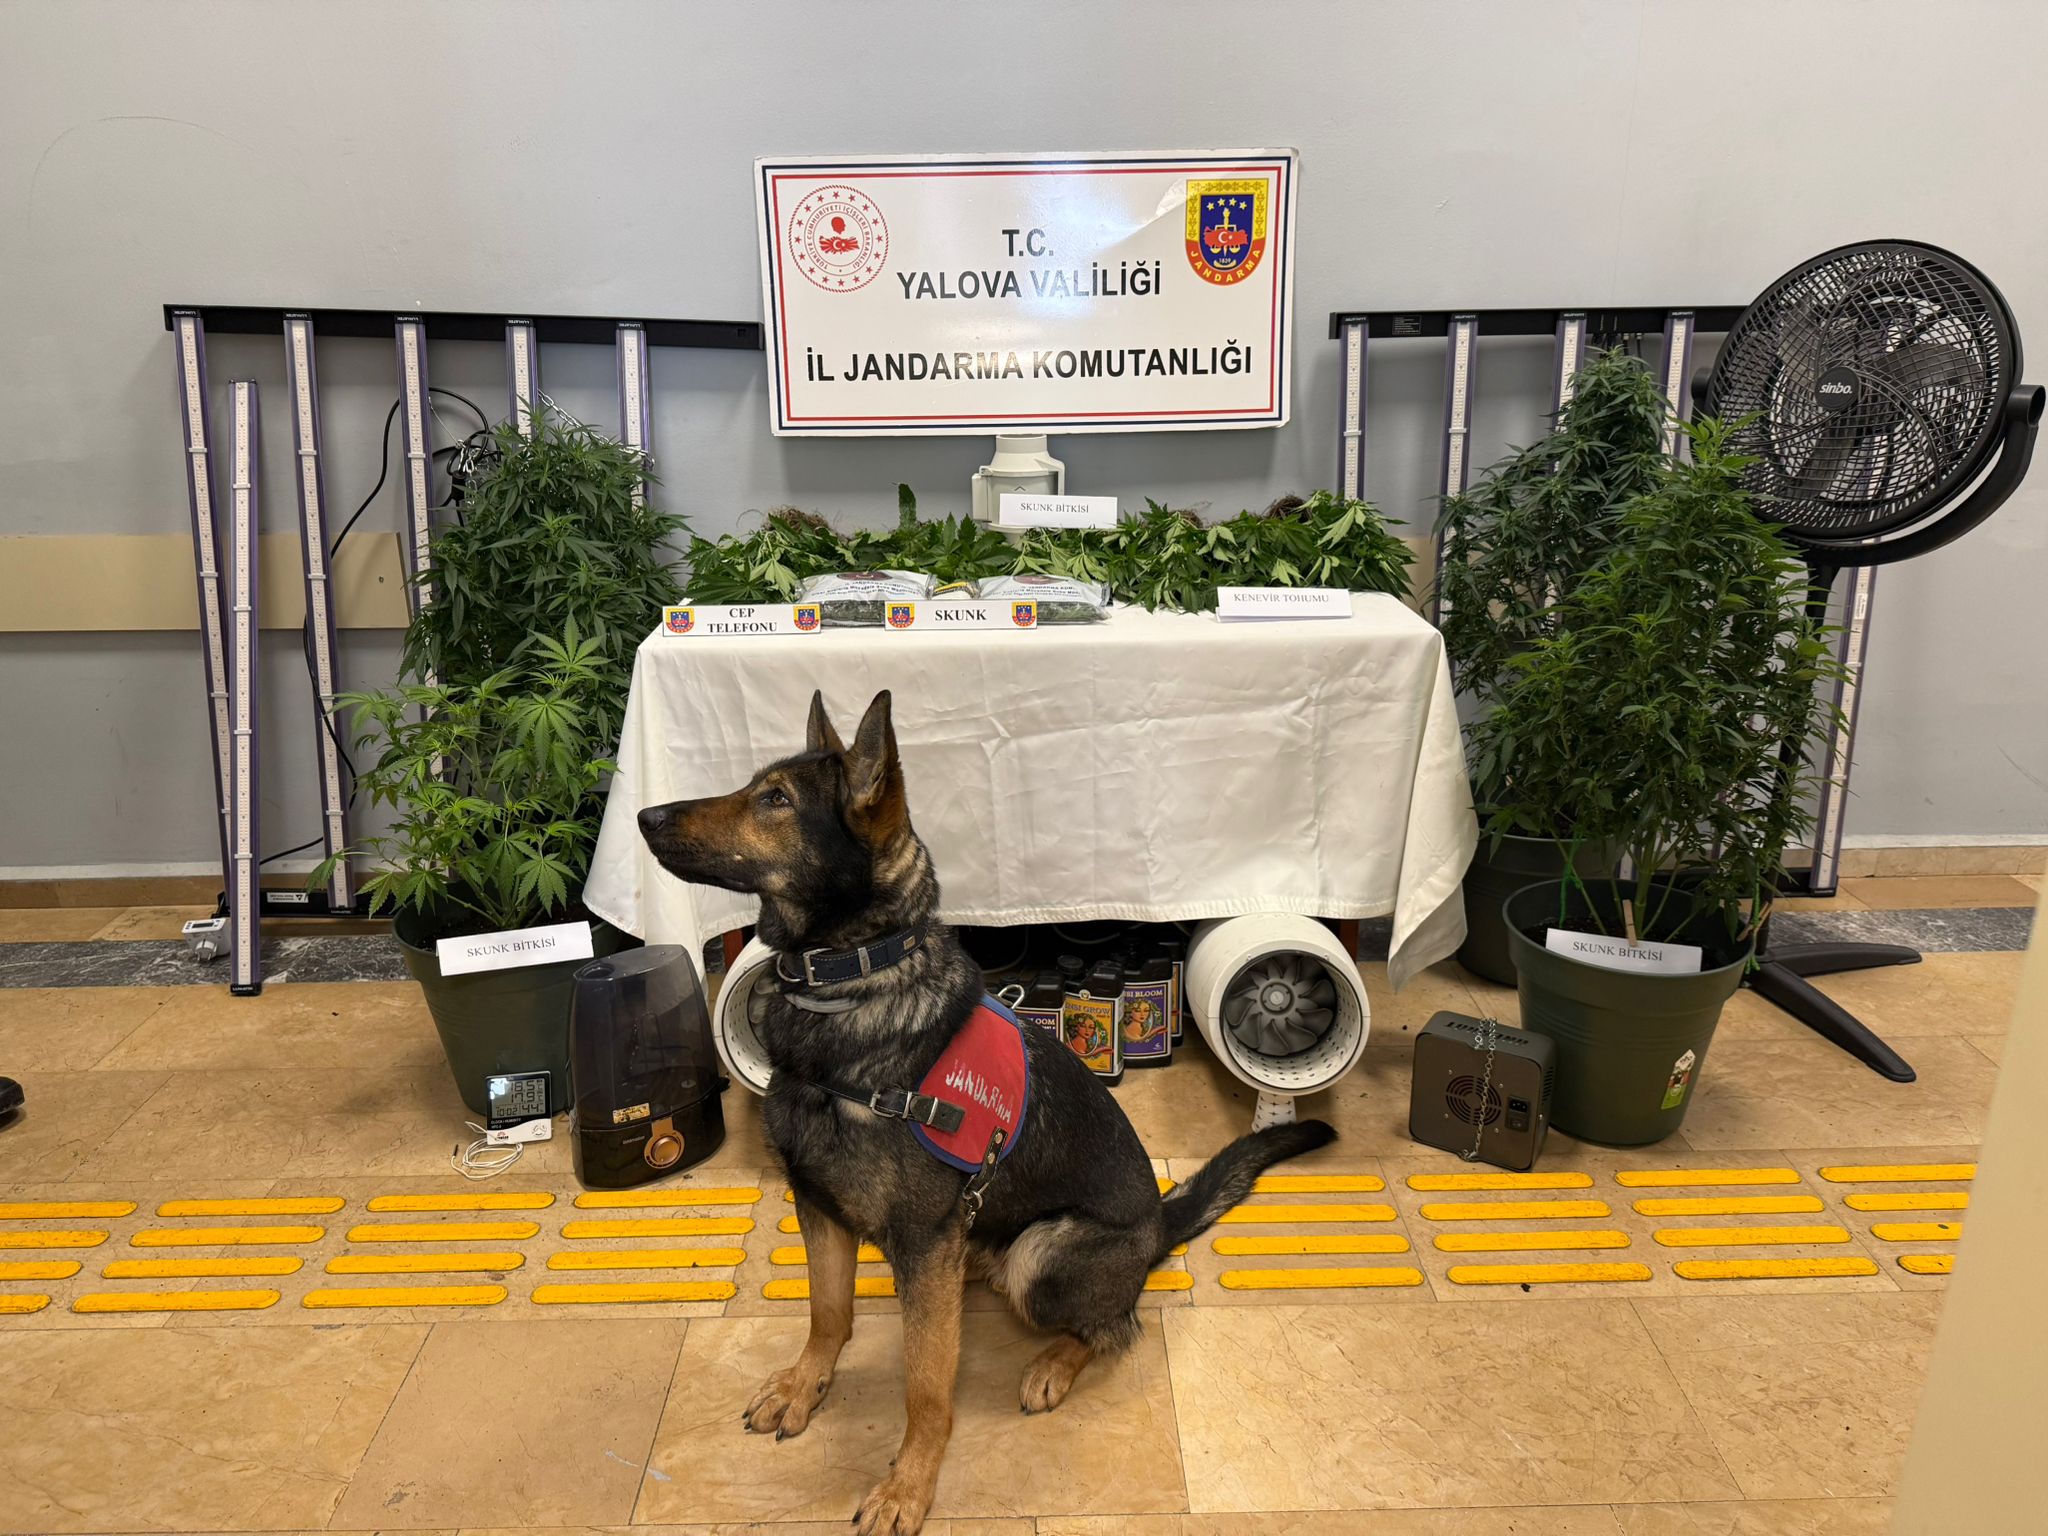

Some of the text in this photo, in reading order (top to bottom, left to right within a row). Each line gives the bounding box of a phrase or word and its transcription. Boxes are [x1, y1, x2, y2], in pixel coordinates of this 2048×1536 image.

[1001, 228, 1054, 257] T.C.
[1190, 250, 1261, 283] JANDARMA
[896, 259, 1161, 300] YALOVA VALİLİĞİ
[806, 338, 1252, 382] İL JANDARMA KOMUTANLIĞI
[1020, 502, 1089, 513] SKUNK BİTKİSİ
[1233, 593, 1329, 603] KENEVİR TOHUMU
[729, 607, 755, 618] CEP
[934, 609, 987, 621] SKUNK
[707, 621, 778, 633] TELEFONU
[467, 937, 556, 957] SKUNK BİTKİSİ
[1572, 941, 1663, 961] SKUNK BİTKİSİ
